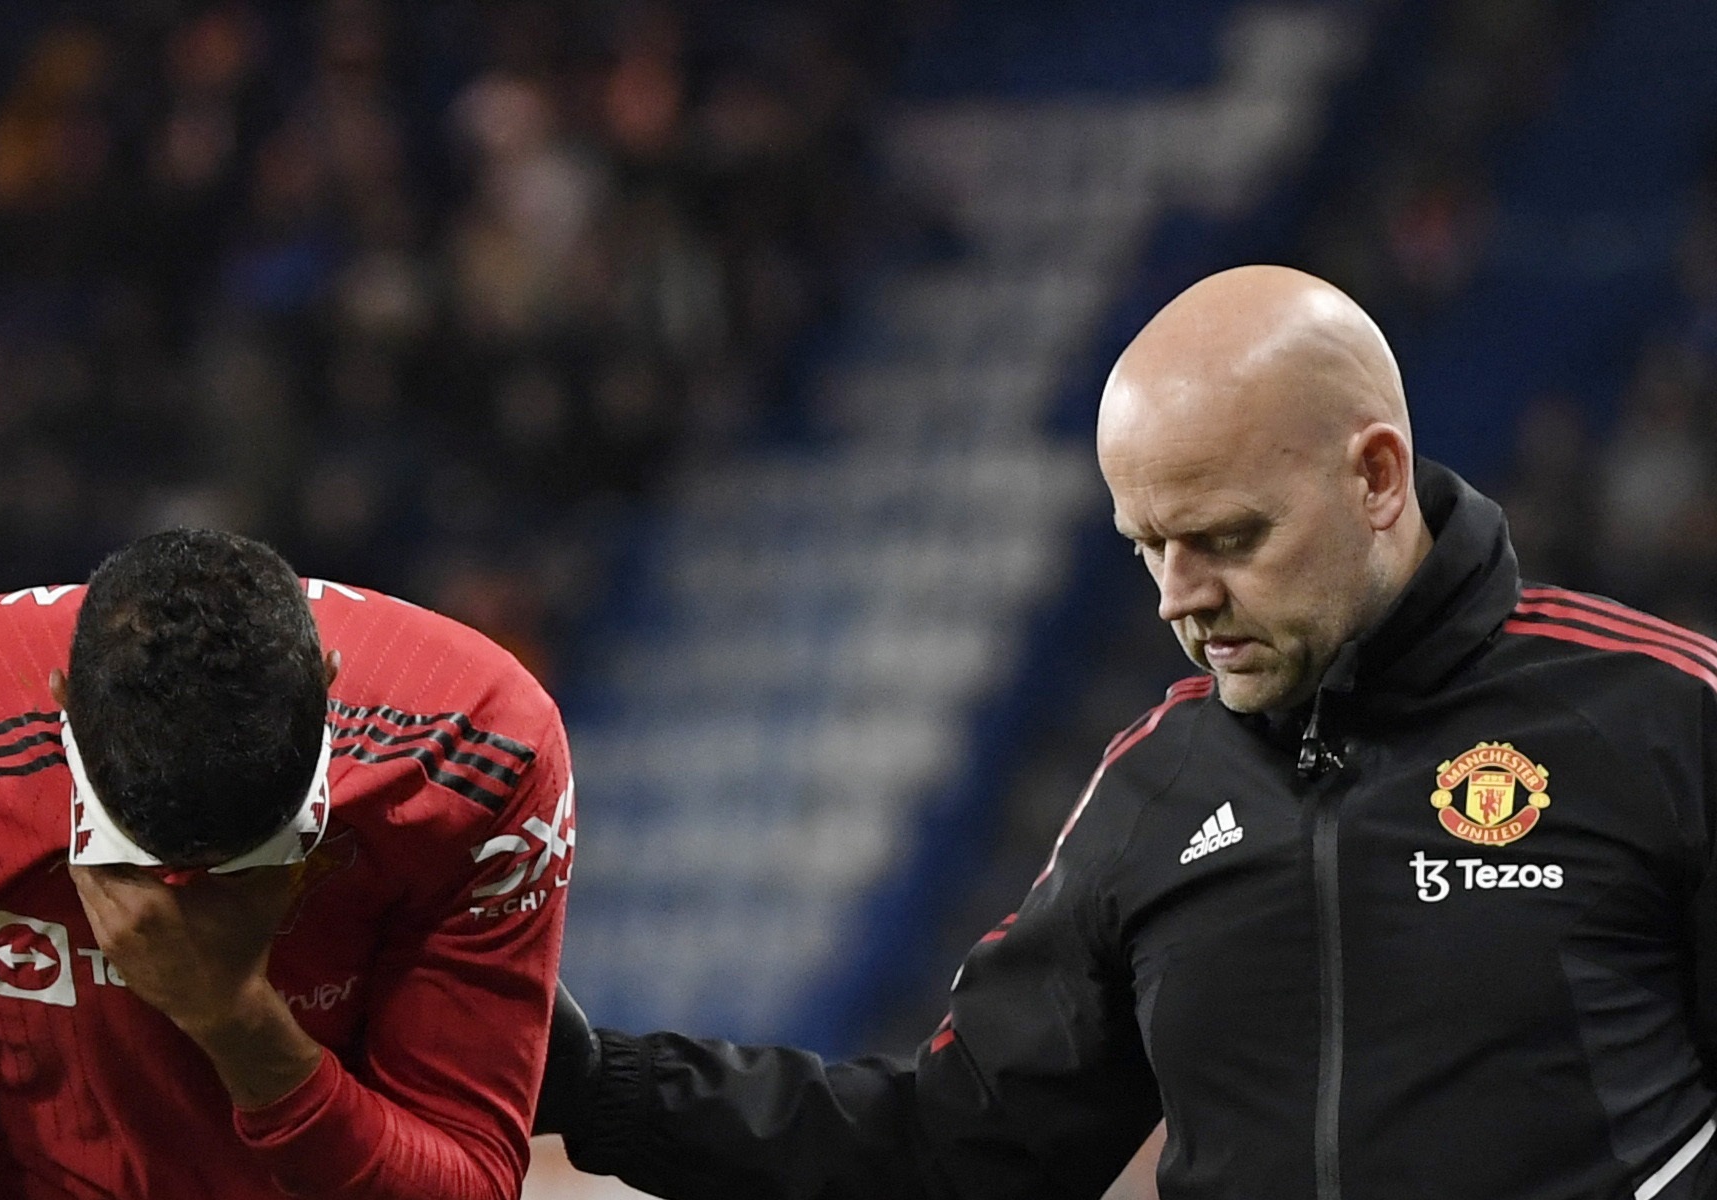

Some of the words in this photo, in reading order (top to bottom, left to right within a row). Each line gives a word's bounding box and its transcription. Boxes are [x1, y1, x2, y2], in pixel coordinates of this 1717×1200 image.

[1445, 749, 1540, 787] MANCHESTER
[1179, 826, 1244, 866] adidas
[1456, 821, 1523, 841] UNITED
[1455, 858, 1564, 890] Tezos
